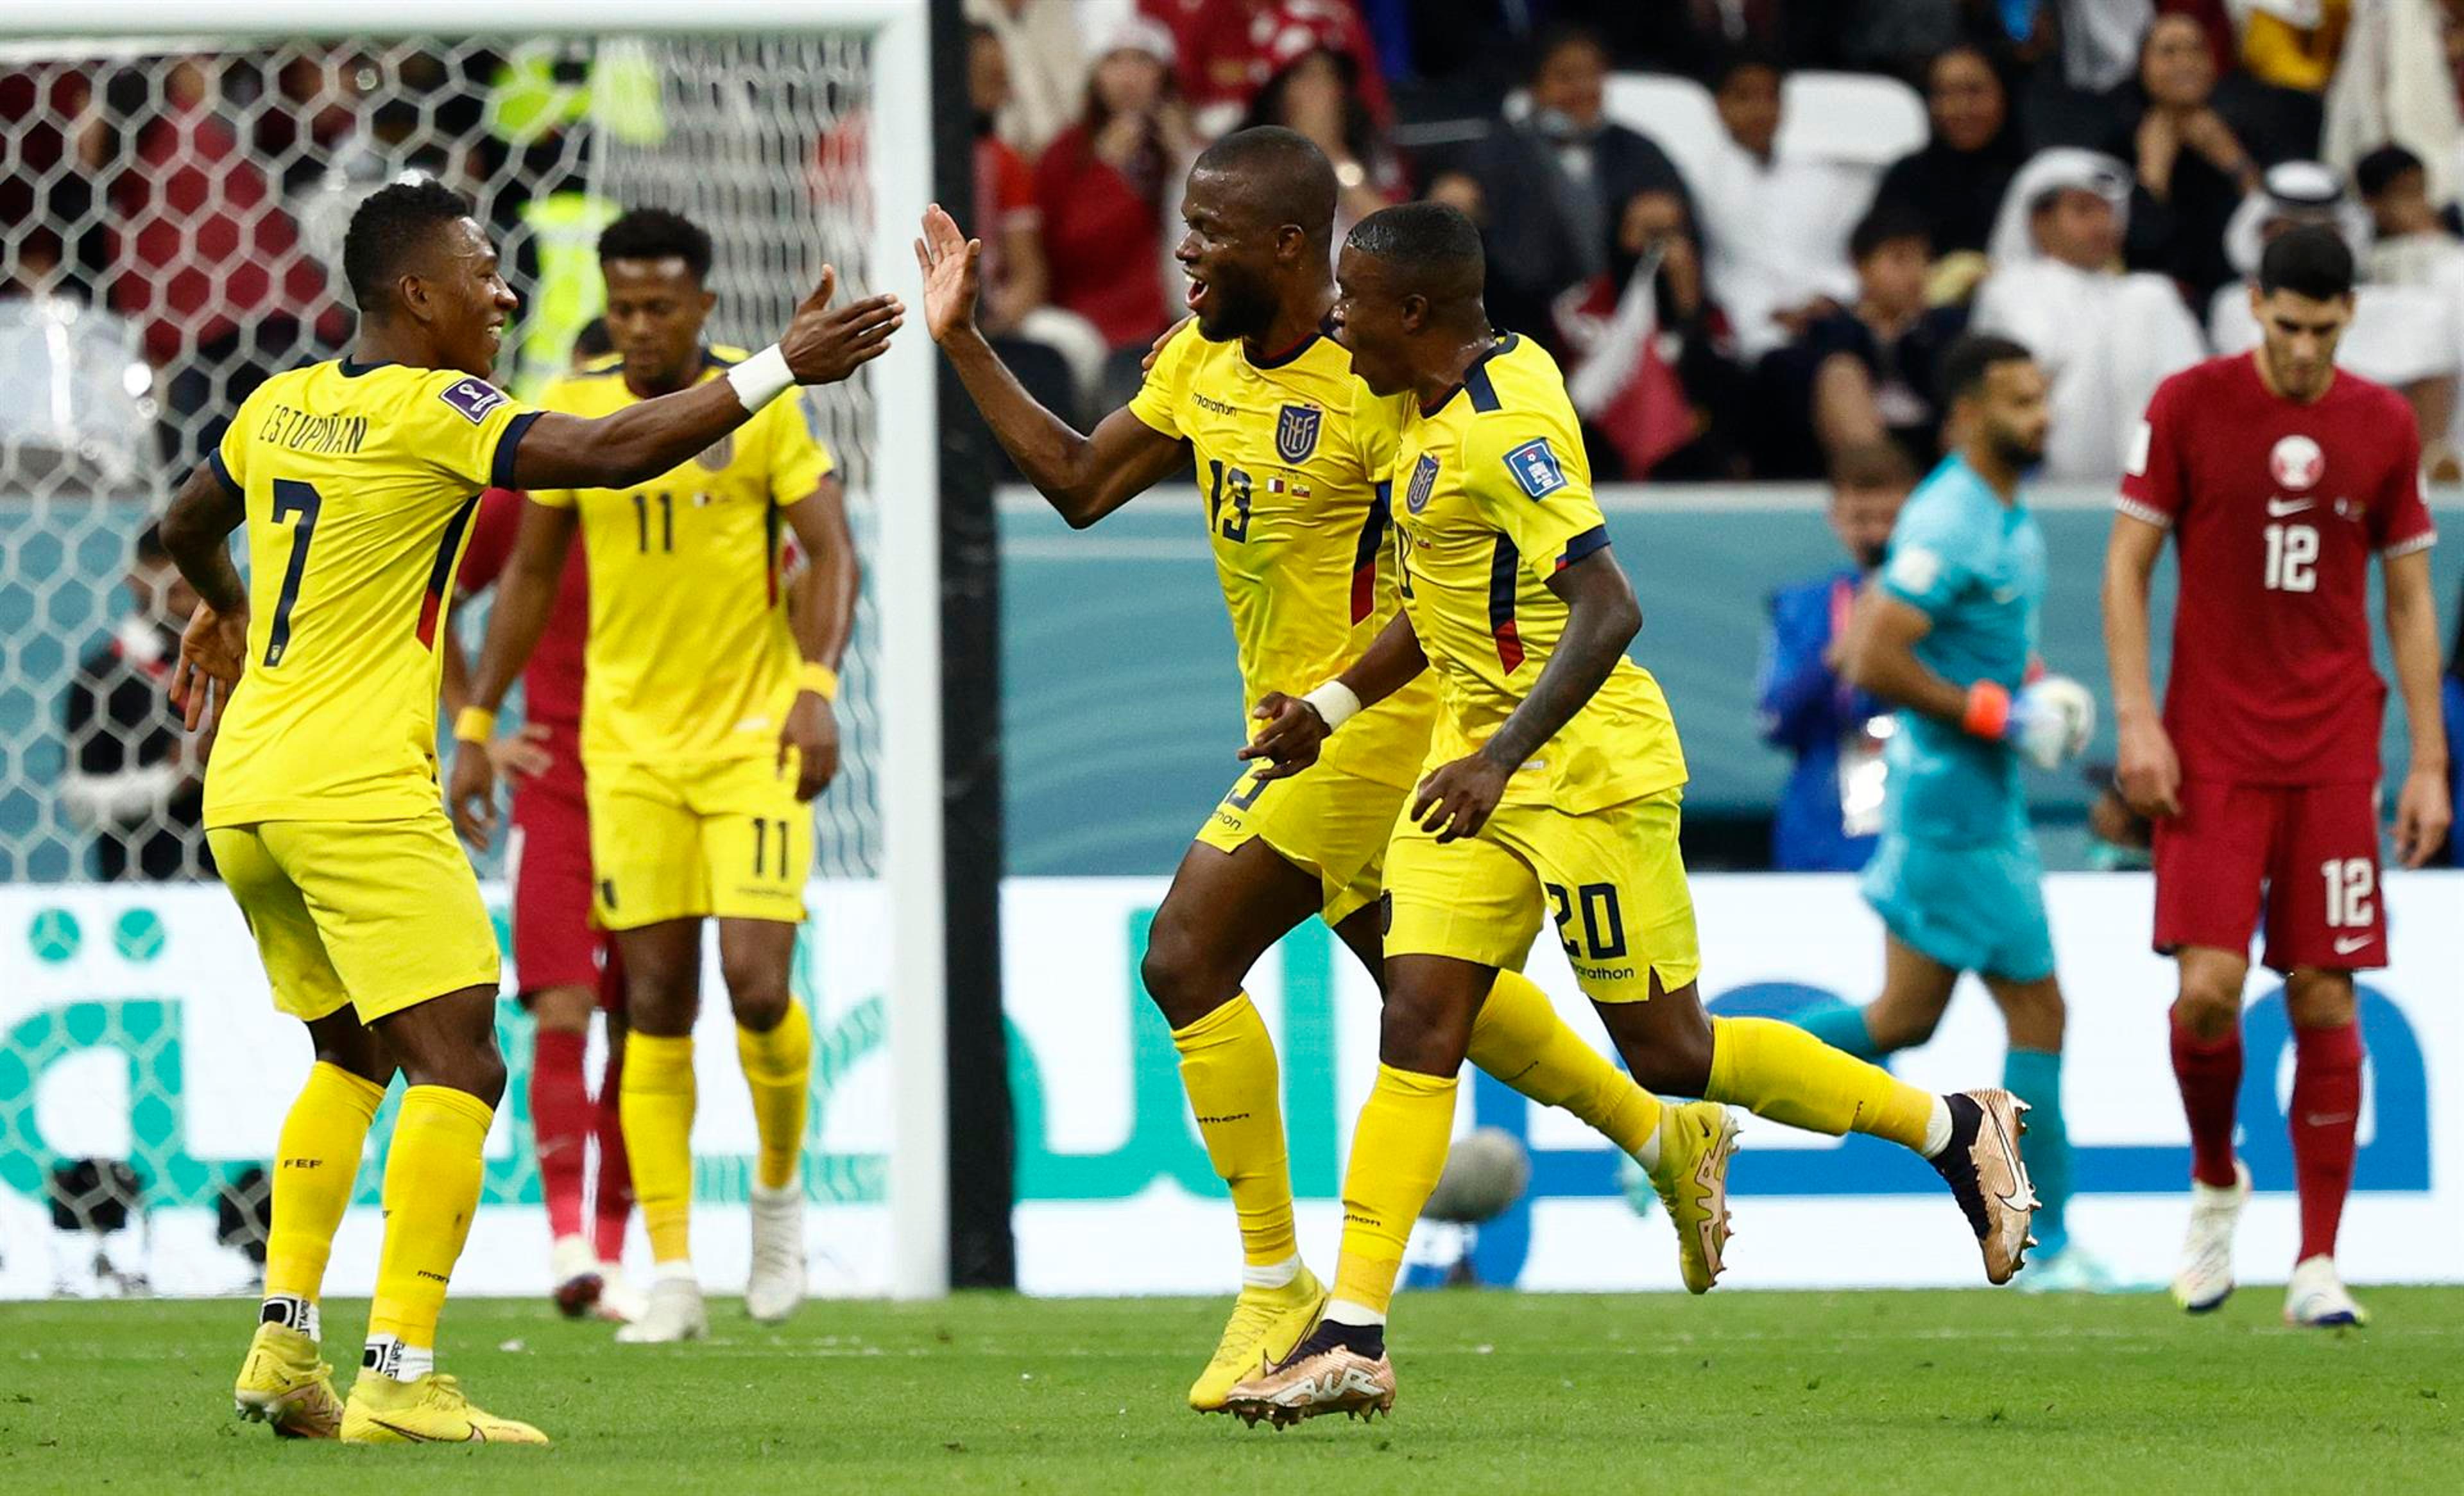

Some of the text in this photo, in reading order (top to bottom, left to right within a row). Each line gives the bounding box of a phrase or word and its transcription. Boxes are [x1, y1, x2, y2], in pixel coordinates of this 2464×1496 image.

[633, 493, 674, 552] 11
[1210, 459, 1253, 544] 13
[263, 478, 322, 667] 7
[2263, 523, 2321, 593] 12
[753, 817, 789, 880] 11
[1543, 881, 1627, 960] 20
[2320, 857, 2375, 928] 12
[283, 1158, 323, 1169] FEF
